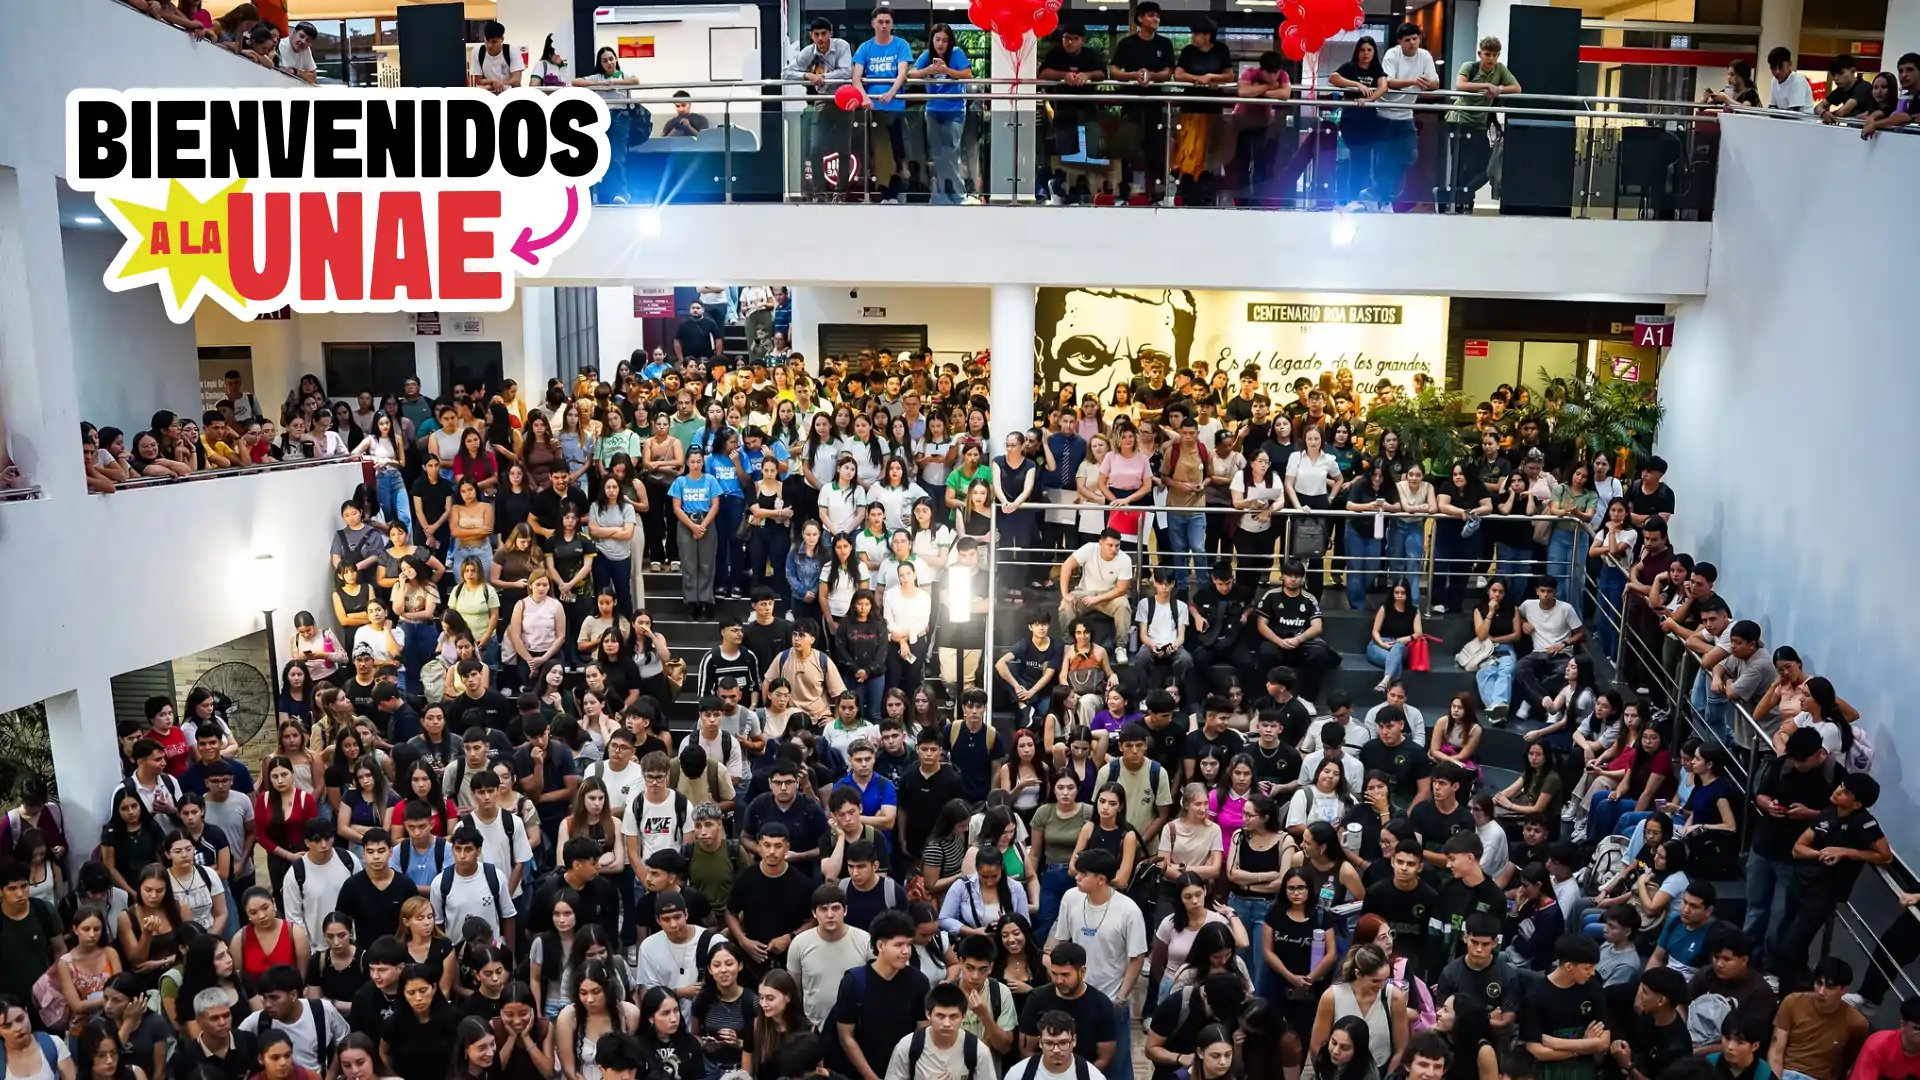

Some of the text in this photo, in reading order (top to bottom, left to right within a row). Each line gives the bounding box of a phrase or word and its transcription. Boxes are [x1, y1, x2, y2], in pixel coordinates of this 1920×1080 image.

[1253, 305, 1396, 323] CENTENARIO ROA BASTOS
[1641, 327, 1663, 346] A1
[1216, 347, 1239, 372] Es
[1269, 352, 1322, 376] legado
[1354, 352, 1373, 370] los
[644, 817, 671, 830] NIKE
